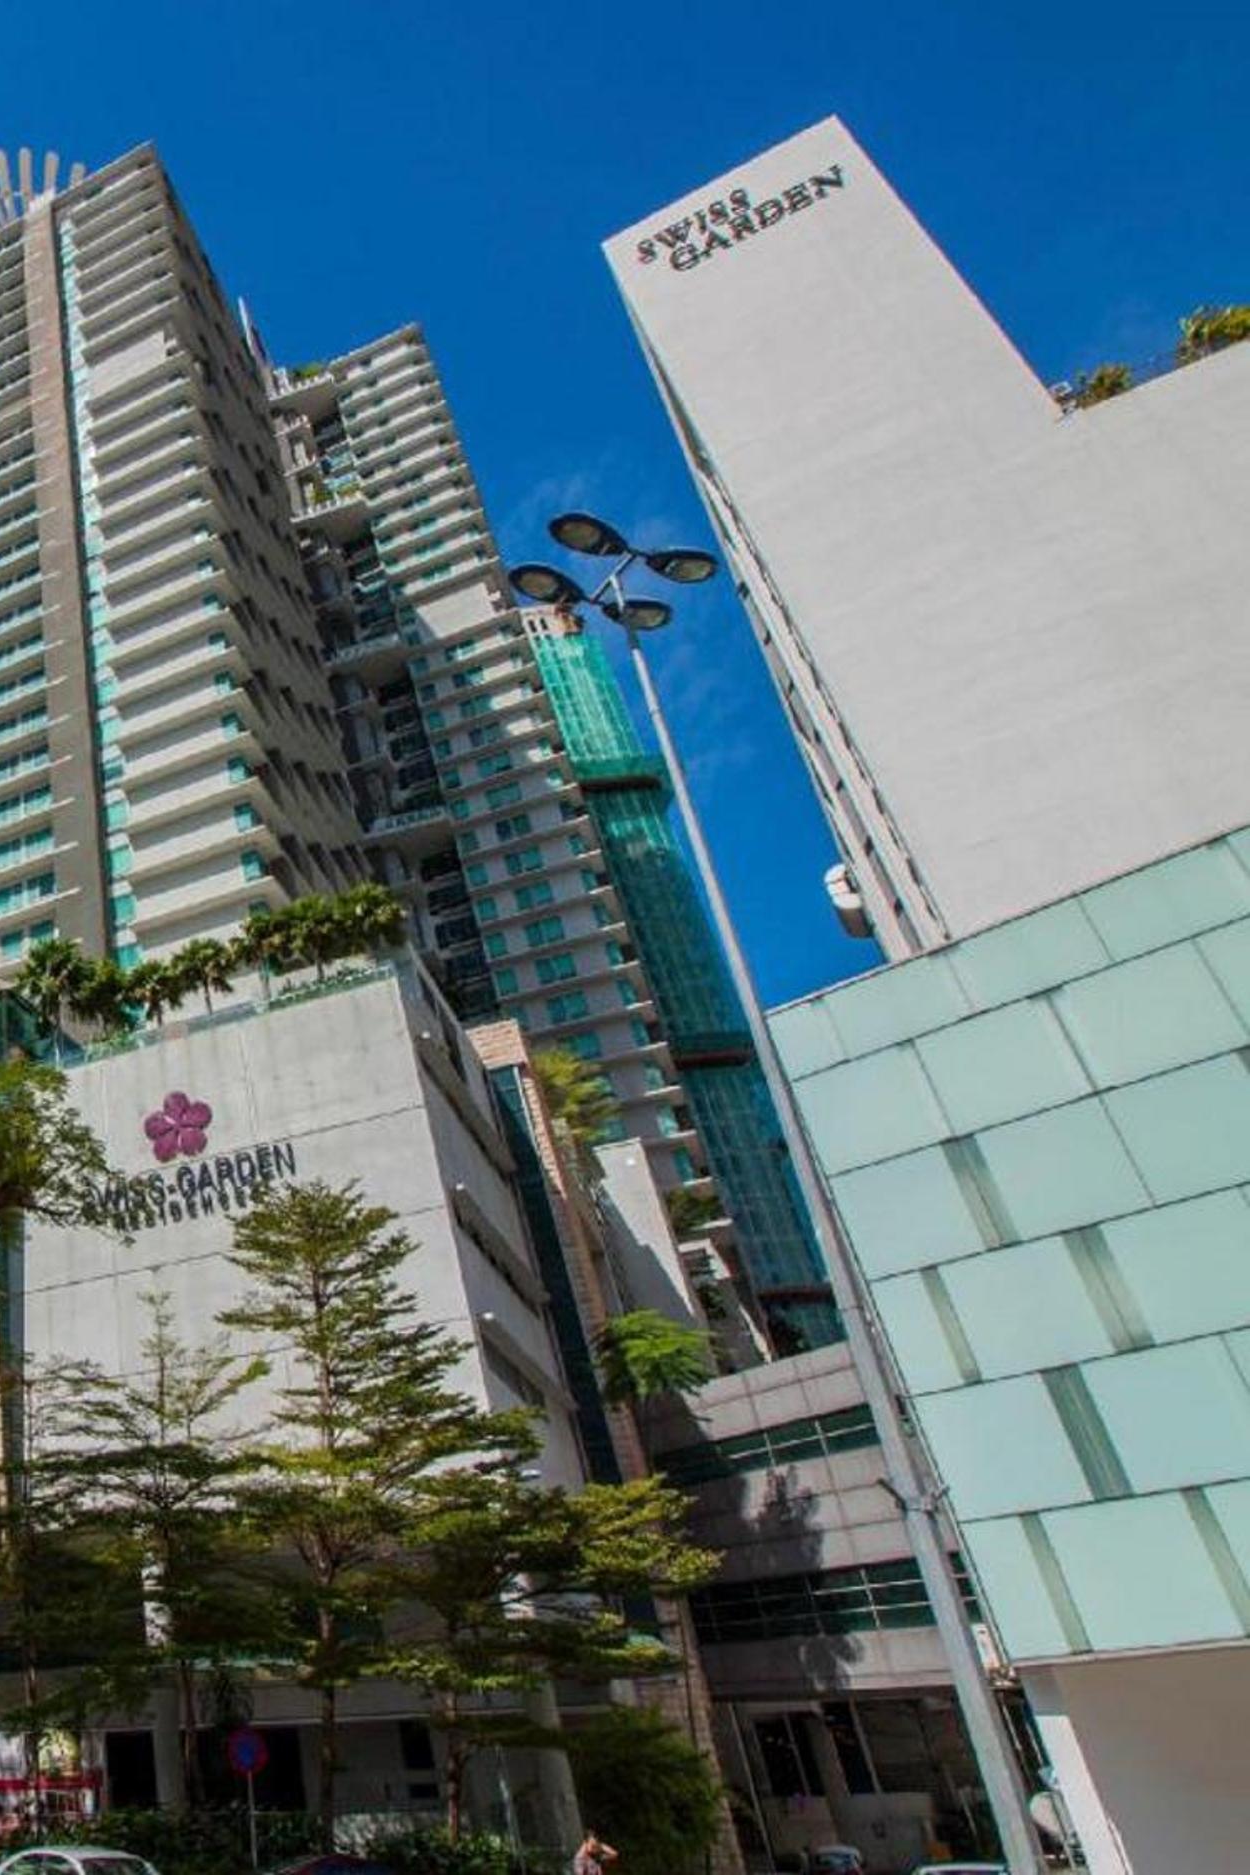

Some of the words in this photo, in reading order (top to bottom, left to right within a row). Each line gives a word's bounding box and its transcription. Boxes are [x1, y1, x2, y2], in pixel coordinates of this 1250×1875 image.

[637, 189, 749, 264] SWISS
[670, 165, 844, 272] GARDEN
[76, 1143, 296, 1213] WISS-GARDEN
